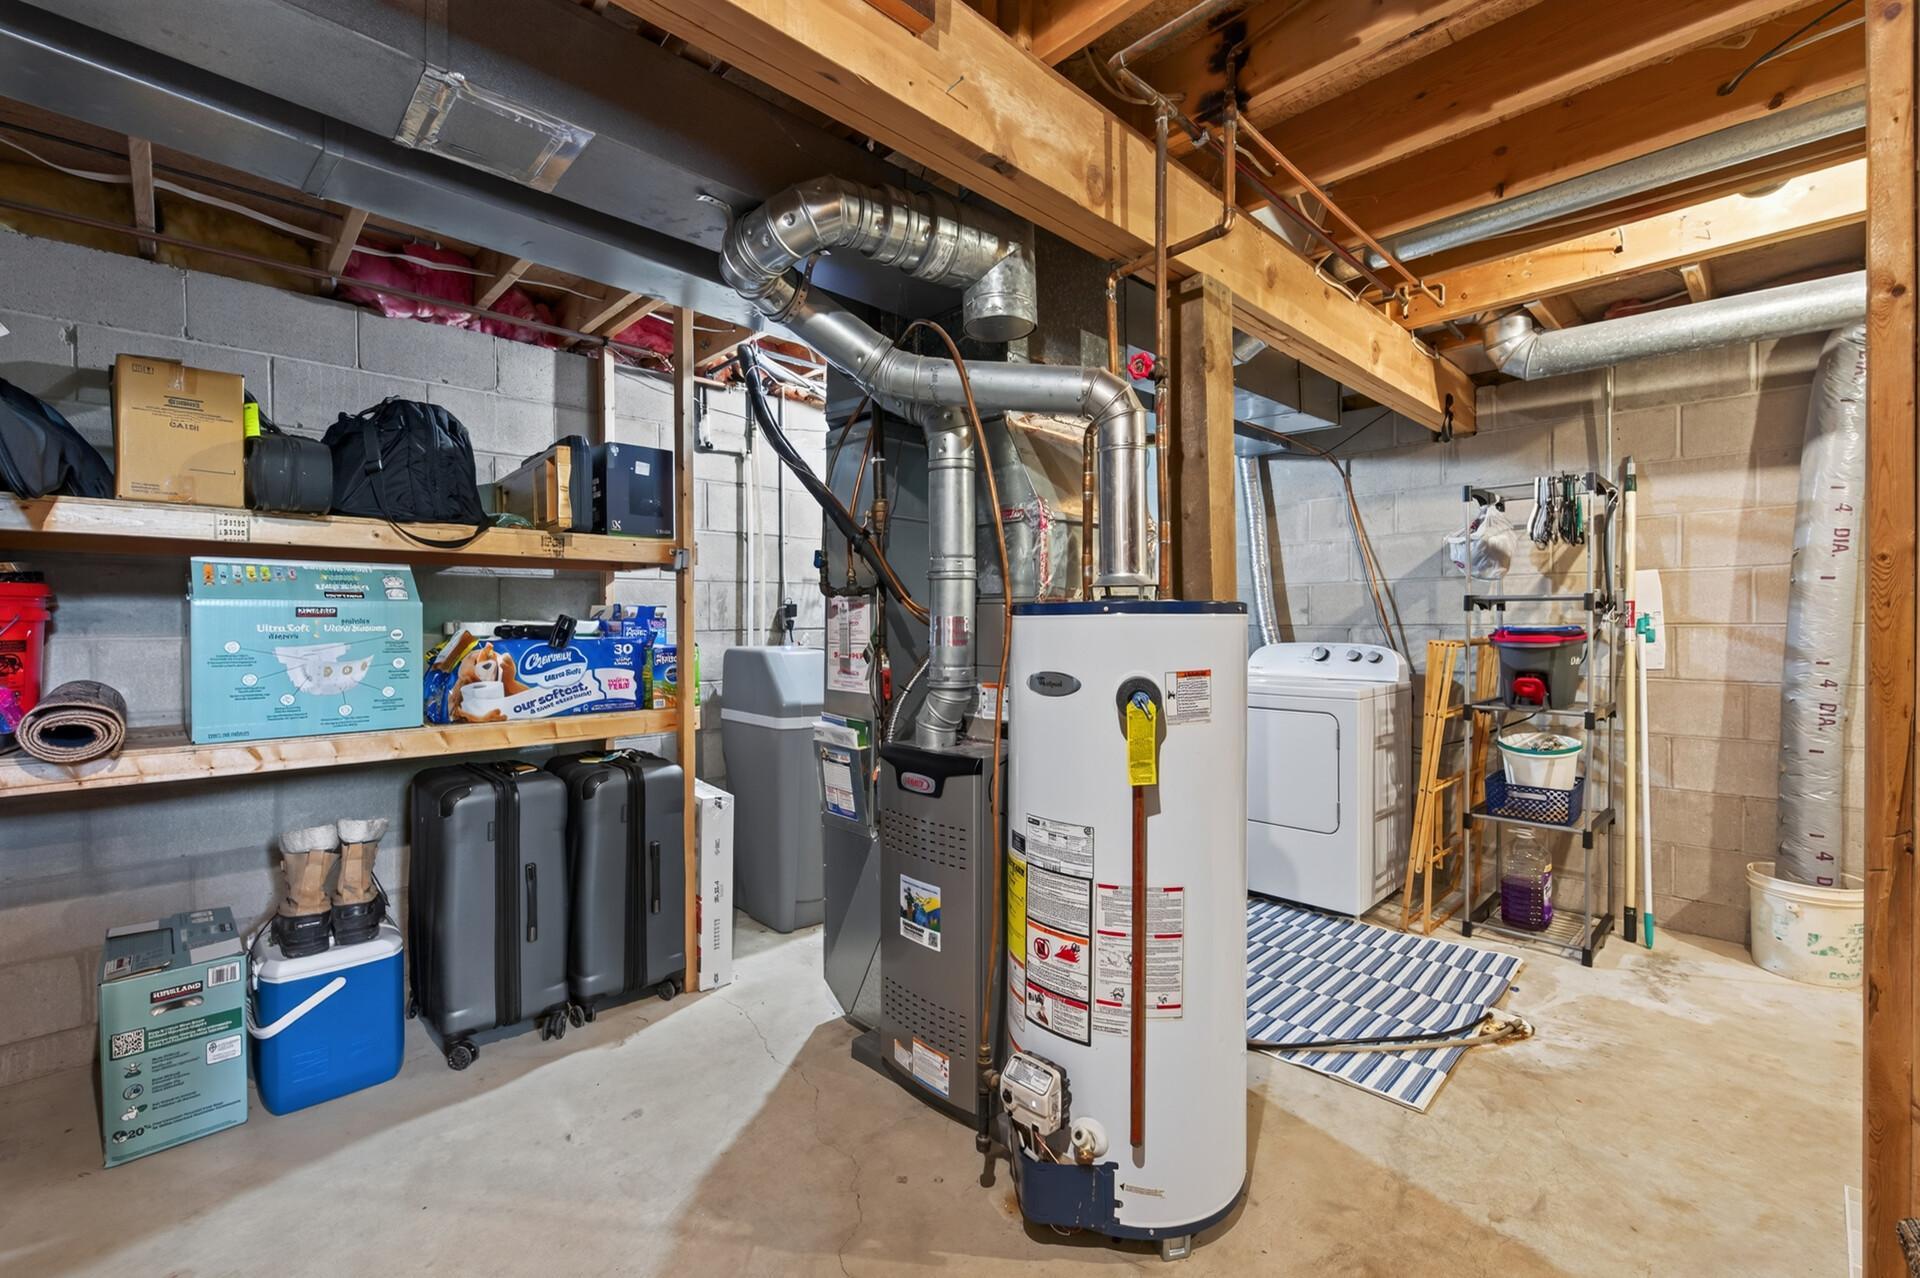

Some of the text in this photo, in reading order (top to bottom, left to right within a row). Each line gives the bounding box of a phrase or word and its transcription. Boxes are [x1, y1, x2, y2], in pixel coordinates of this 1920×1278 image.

[1831, 528, 1850, 557] DIA.
[256, 623, 310, 633] Ultra Soft
[613, 643, 633, 655] 30
[544, 671, 565, 682] Ultra
[513, 697, 537, 714] our
[538, 681, 589, 705] softest,
[1818, 702, 1837, 731] DIA.
[152, 982, 202, 999] KIRKLAND
